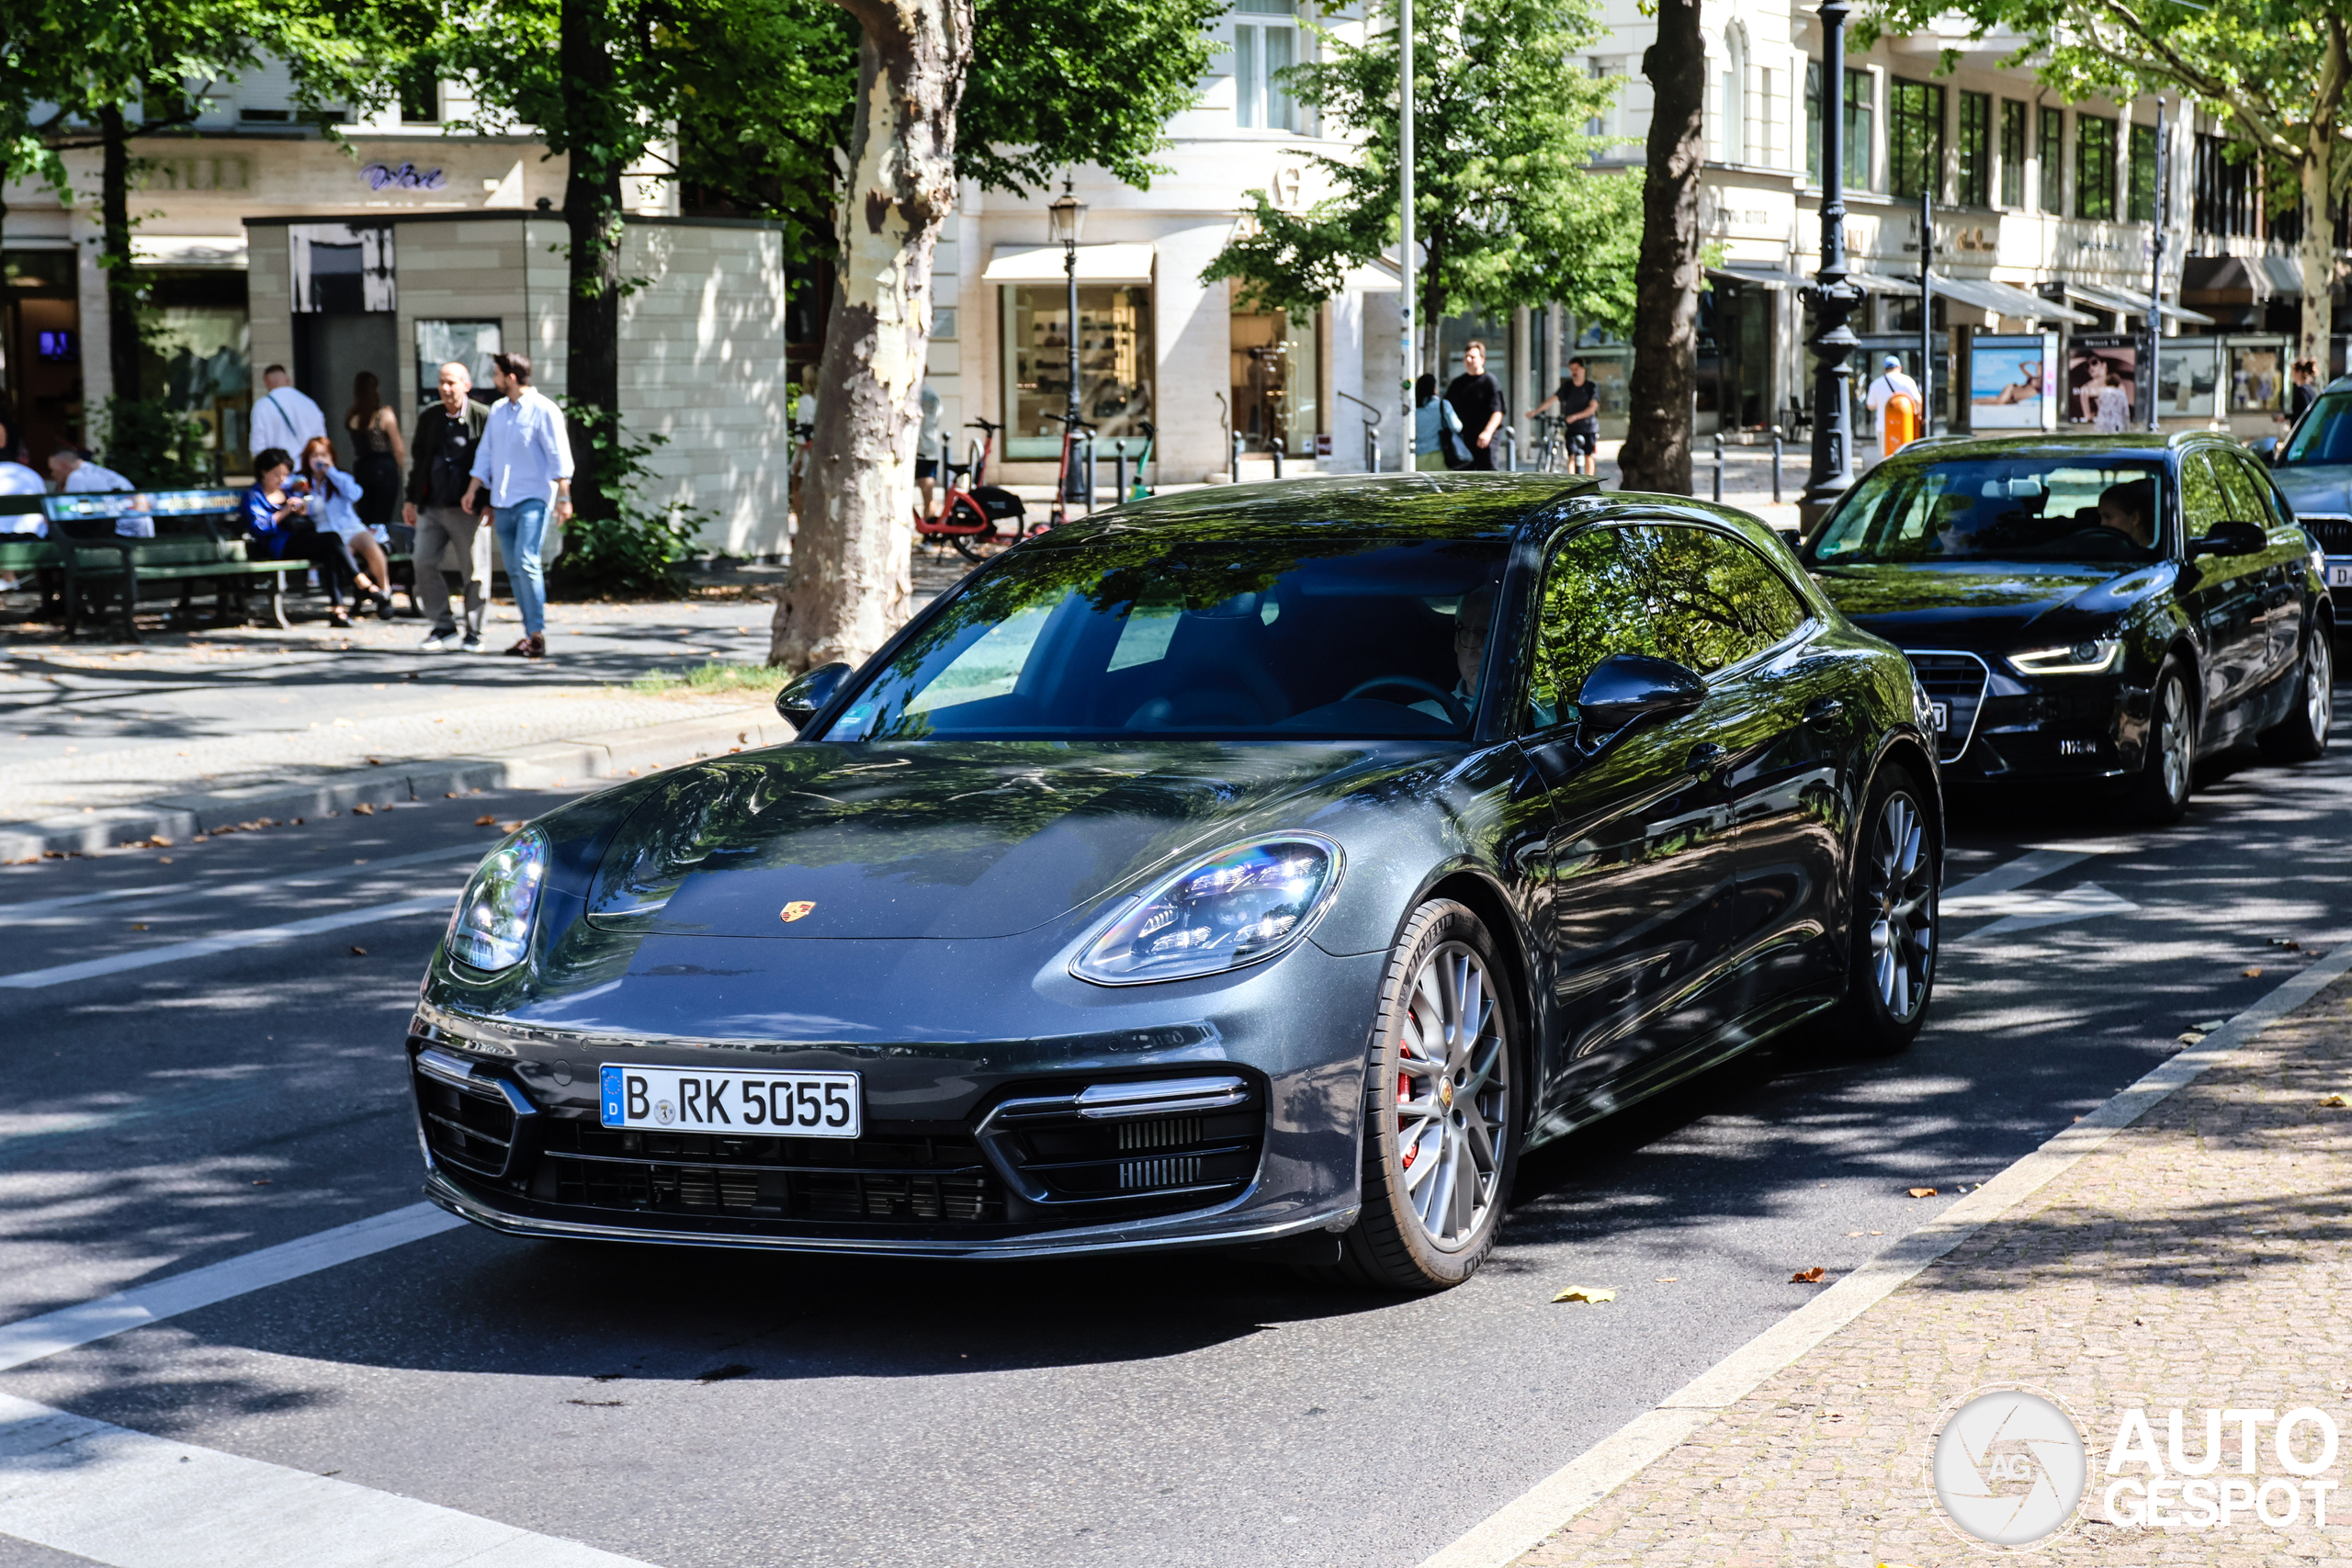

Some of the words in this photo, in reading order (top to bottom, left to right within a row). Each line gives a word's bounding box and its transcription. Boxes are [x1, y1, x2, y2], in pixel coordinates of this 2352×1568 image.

[1408, 914, 1453, 979] MICHELIN
[608, 1102, 618, 1115] D
[627, 1076, 650, 1119] B
[679, 1078, 731, 1123] RK
[742, 1081, 850, 1127] 5055
